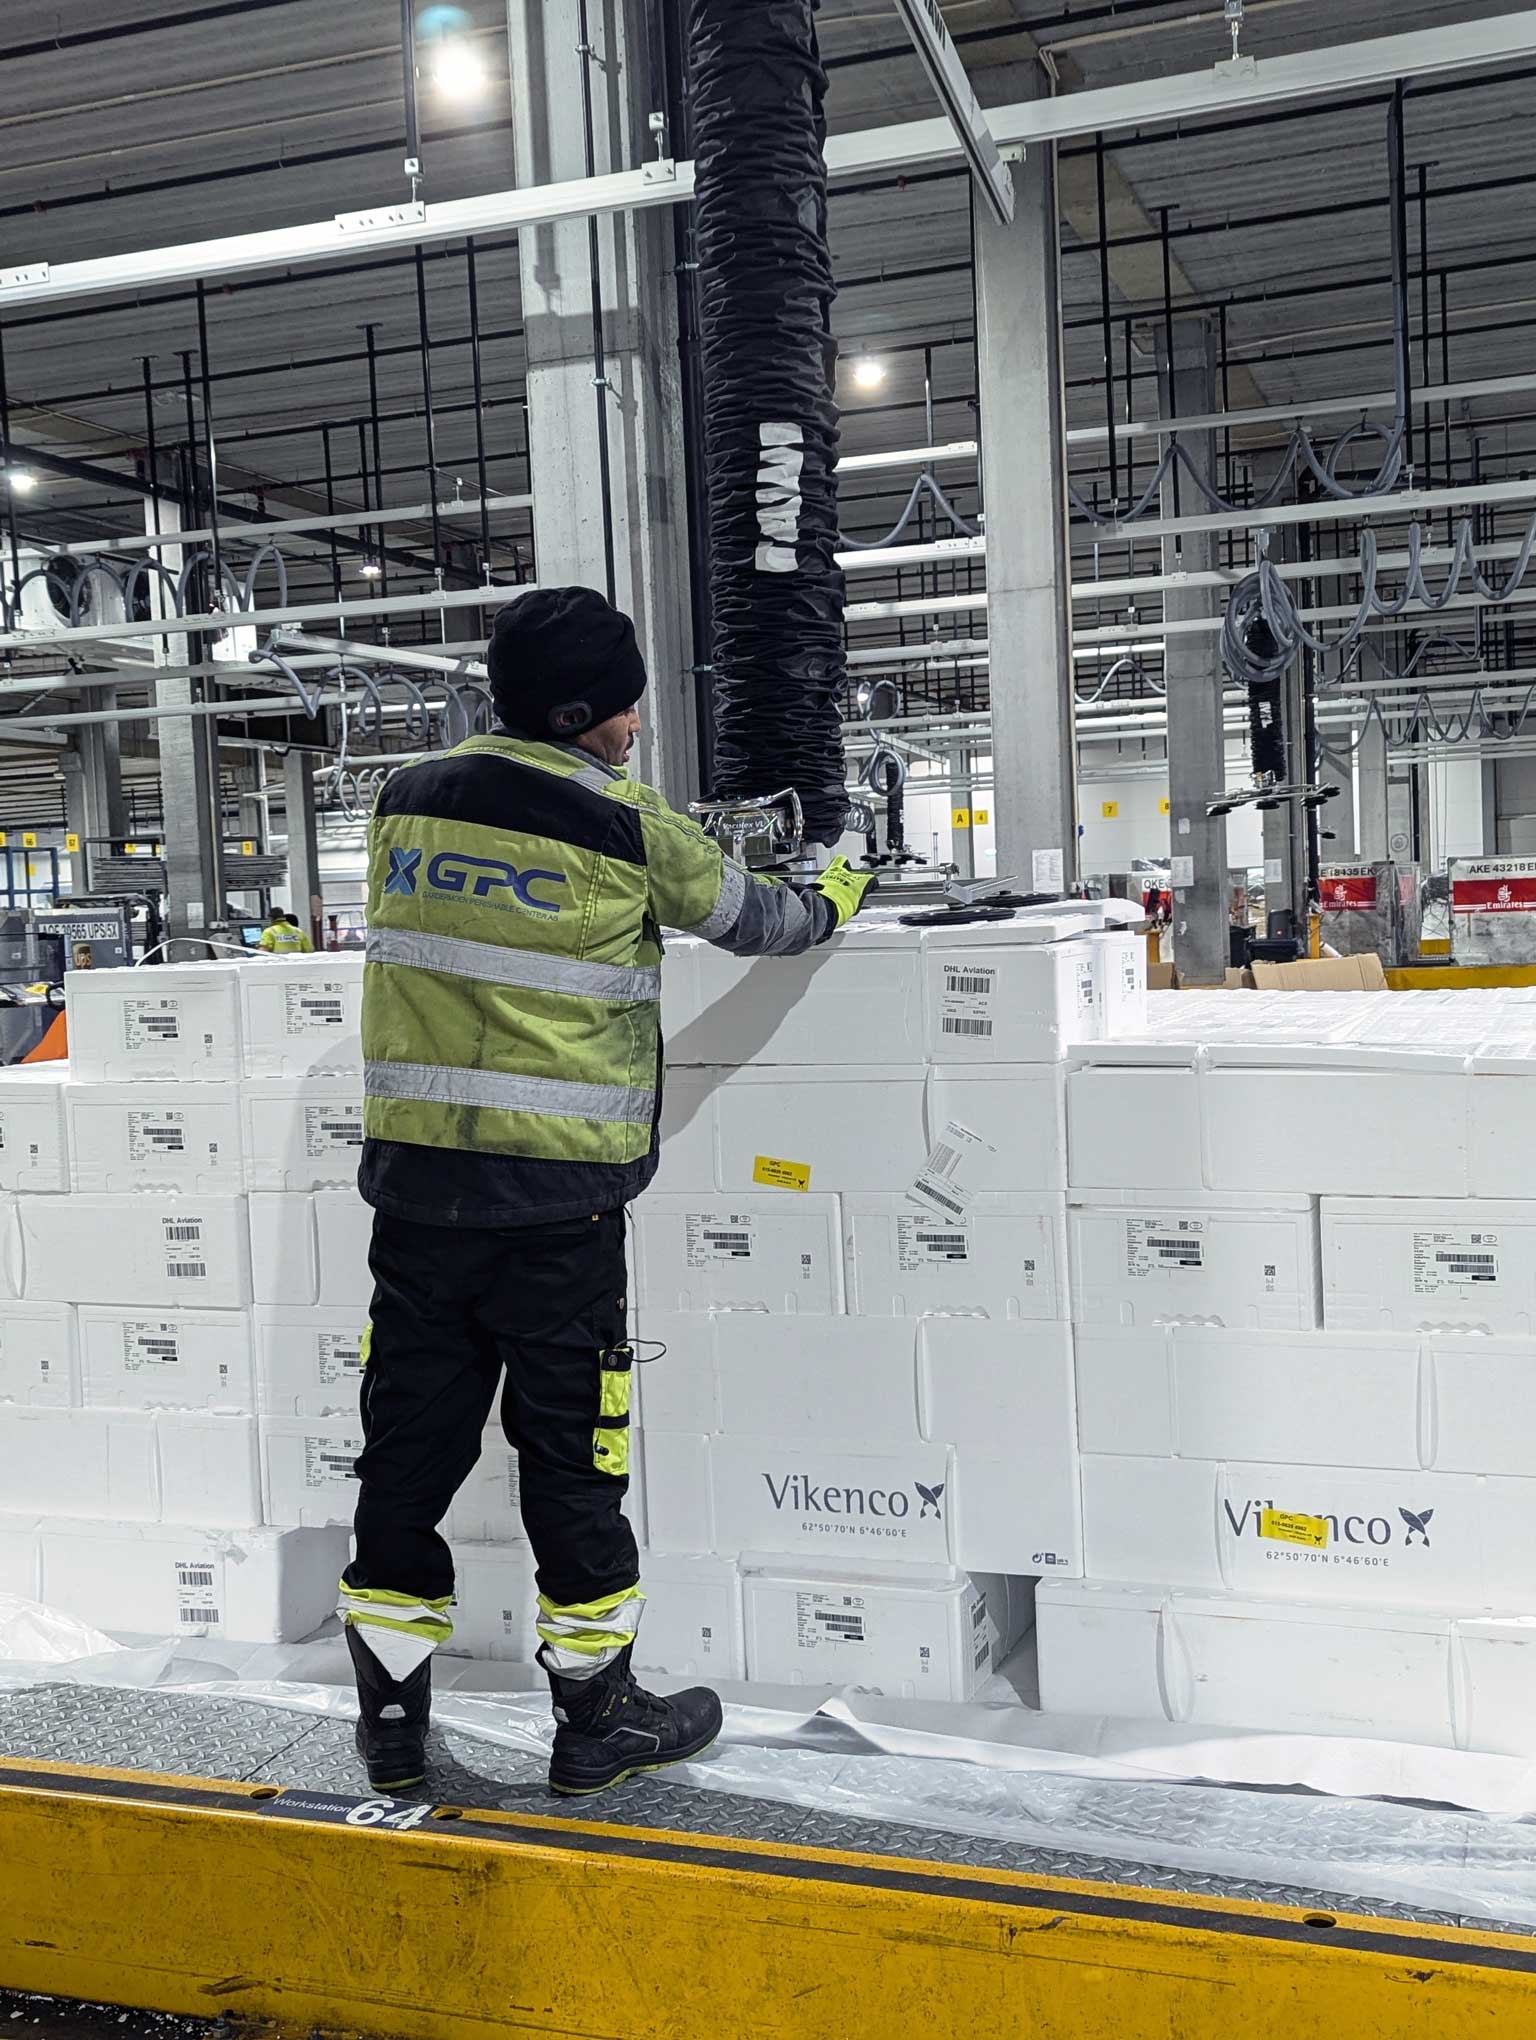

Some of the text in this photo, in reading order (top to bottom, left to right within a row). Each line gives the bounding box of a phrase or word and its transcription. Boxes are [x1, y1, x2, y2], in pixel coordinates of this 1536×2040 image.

[1107, 805, 1113, 814] 7
[956, 813, 964, 824] A
[1469, 864, 1491, 874] AKE
[1492, 862, 1526, 872] 43218
[427, 852, 567, 912] GPC
[1486, 901, 1523, 909] Emirates
[943, 964, 996, 975] DHL Aviation
[761, 1472, 909, 1518] Vikenco
[1224, 1498, 1391, 1545] Vinco
[273, 1797, 433, 1830] Workstation 64
